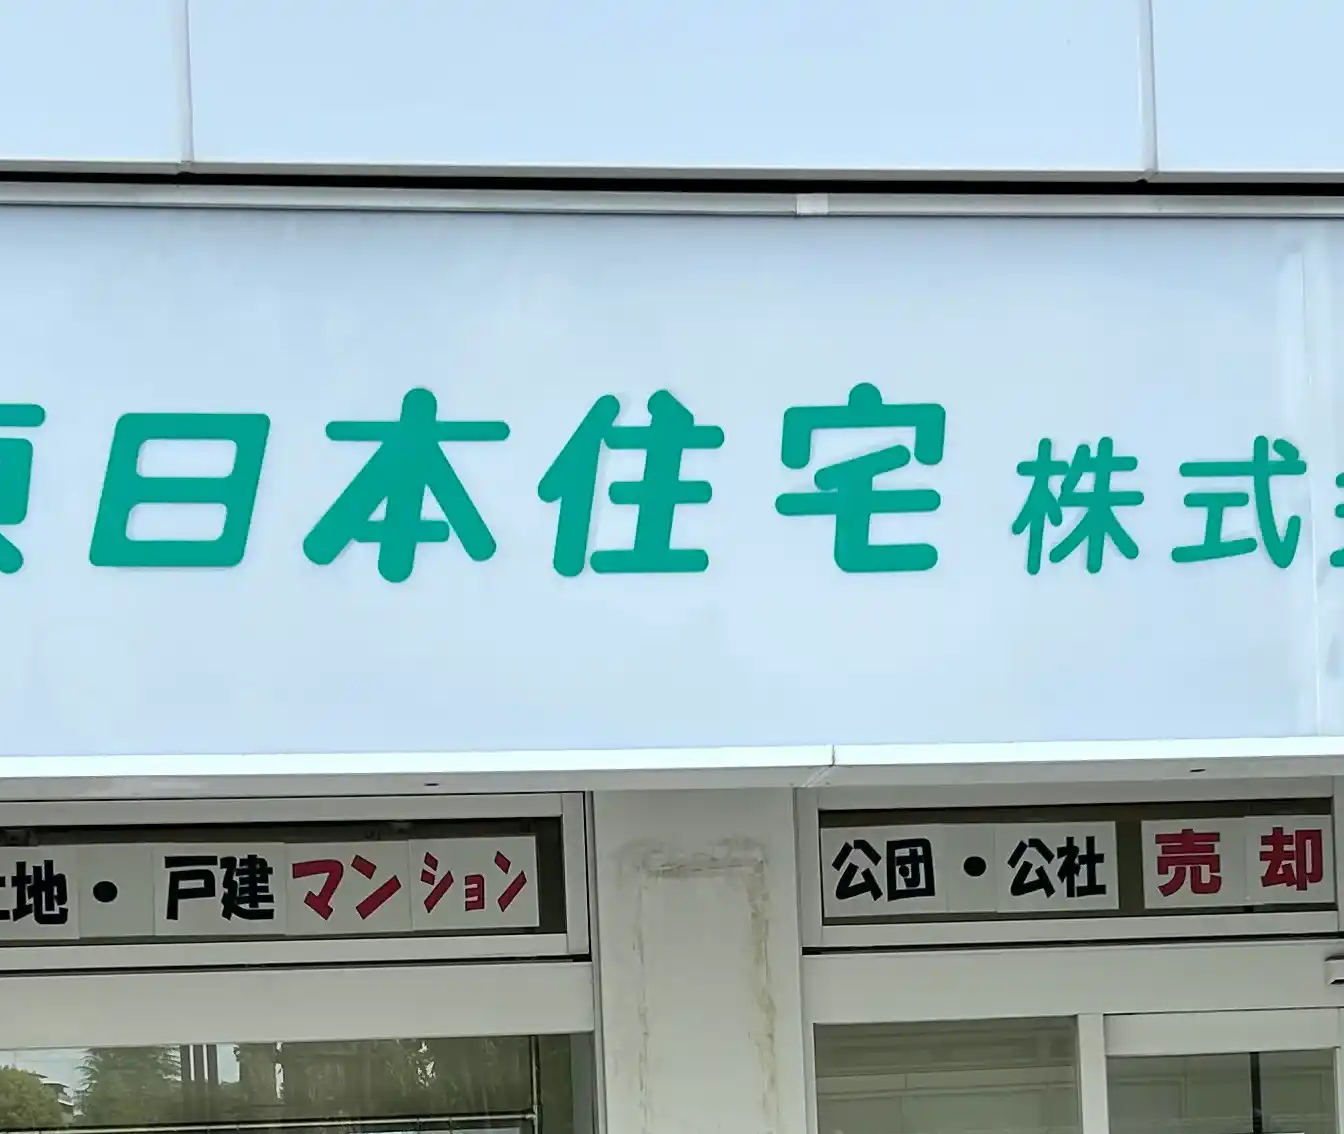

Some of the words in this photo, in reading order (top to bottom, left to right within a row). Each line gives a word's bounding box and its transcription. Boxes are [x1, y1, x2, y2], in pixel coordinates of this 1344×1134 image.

[831, 835, 1107, 902] 公団・公社
[1155, 826, 1324, 897] 売却
